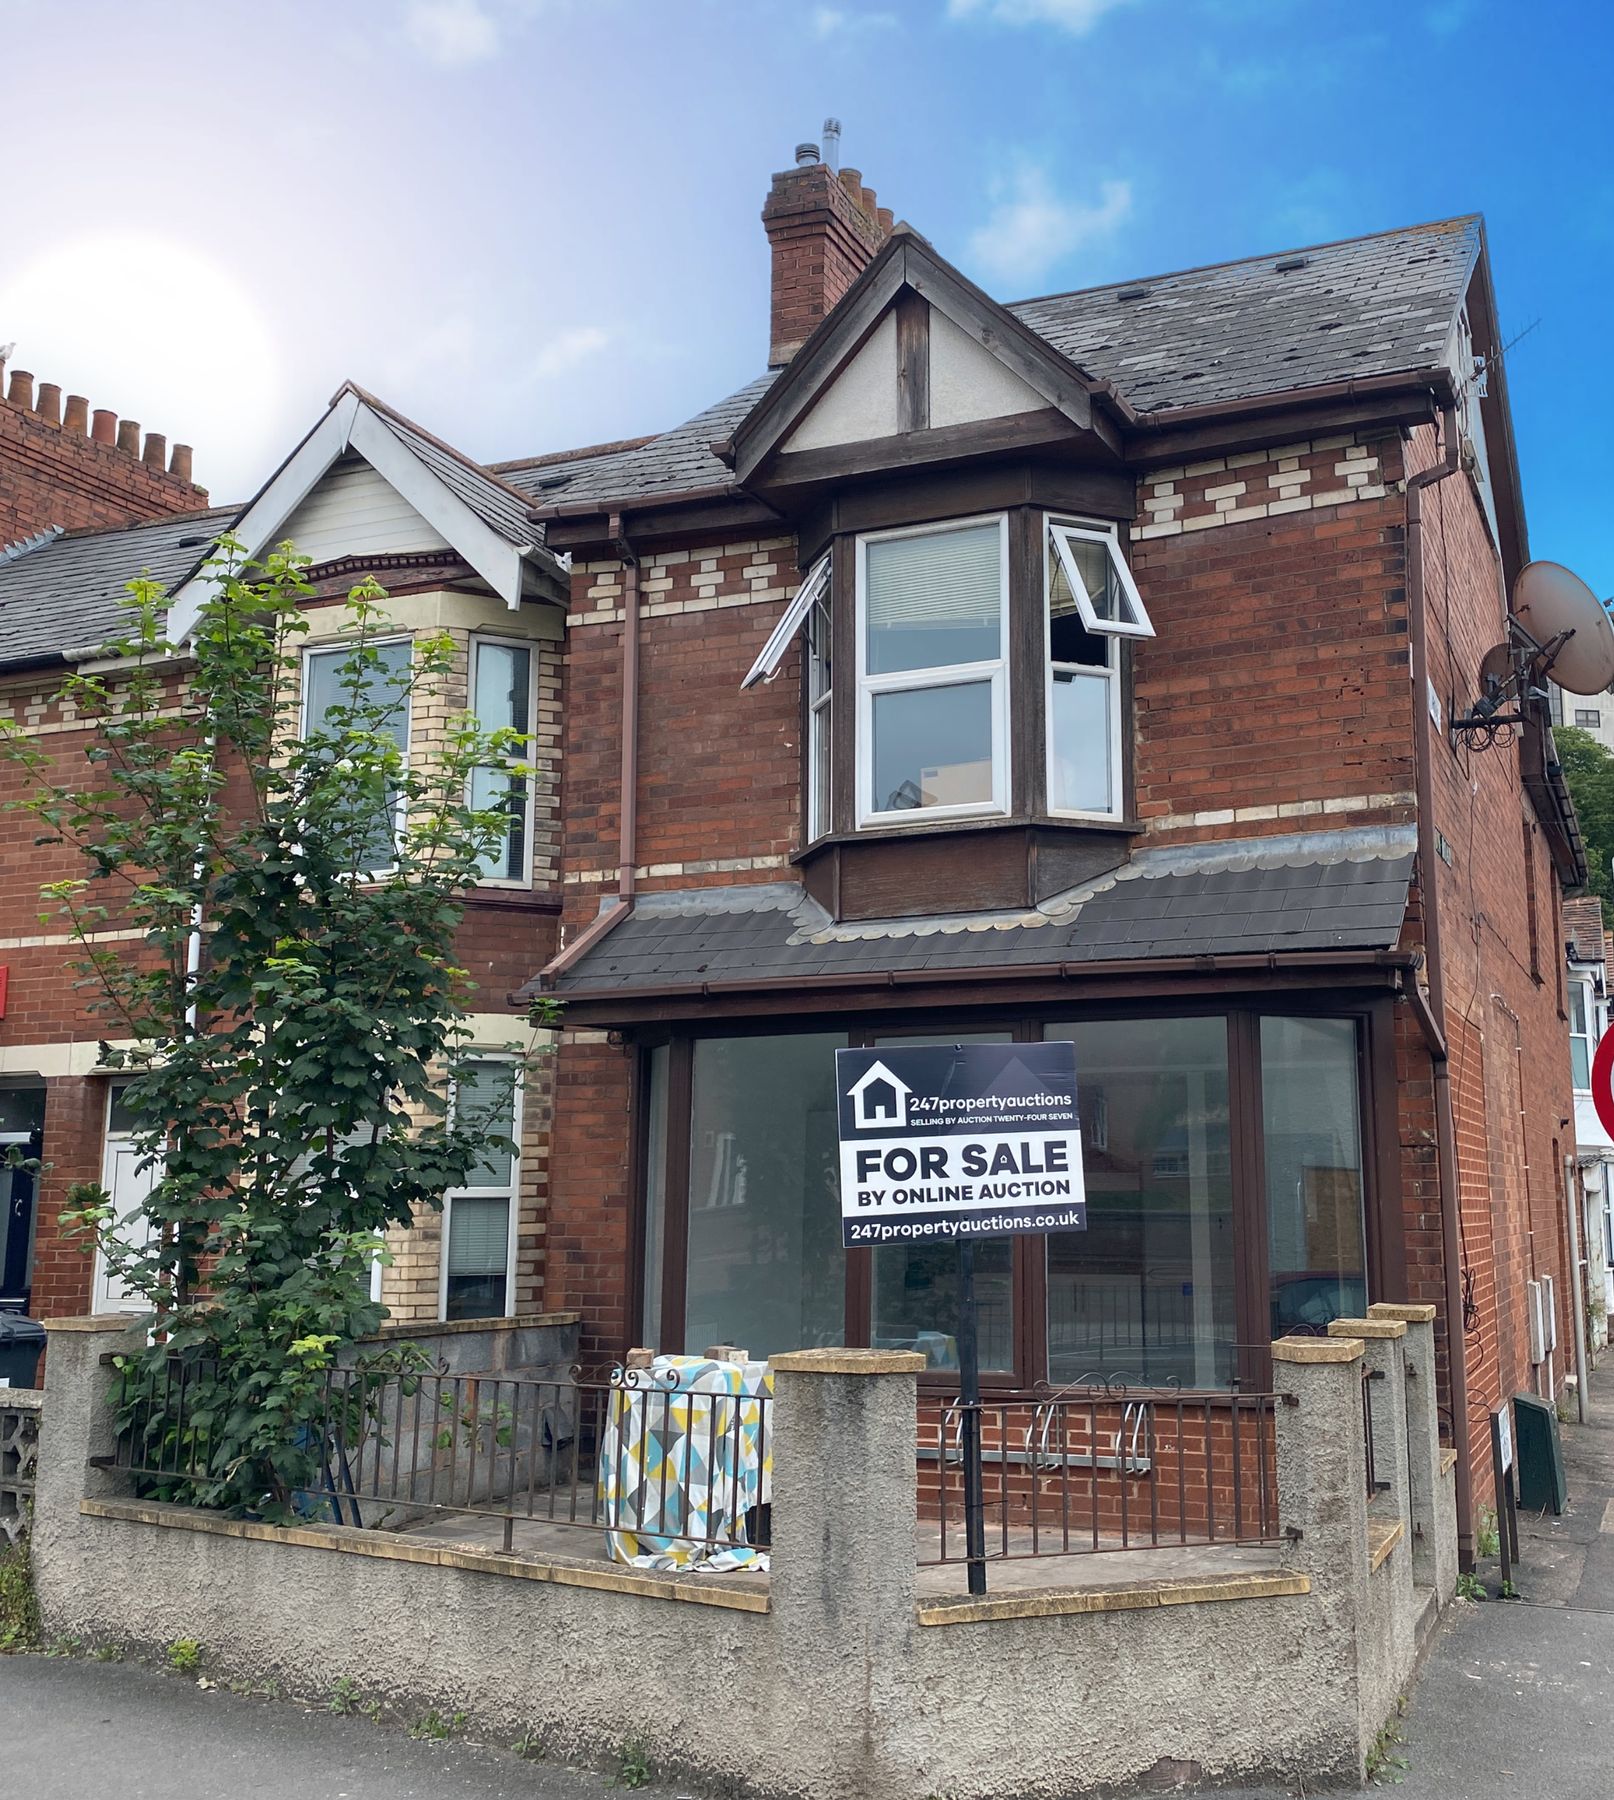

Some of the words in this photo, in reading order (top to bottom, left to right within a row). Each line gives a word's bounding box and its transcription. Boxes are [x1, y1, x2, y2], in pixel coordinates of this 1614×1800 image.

[909, 1093, 1072, 1113] 247propertyauctions
[910, 1117, 944, 1126] SELLING
[945, 1117, 956, 1125] BY
[957, 1115, 992, 1124] AUCTION
[993, 1113, 1047, 1123] TWENTY-FOUR
[1047, 1112, 1073, 1120] SEVEN
[856, 1146, 950, 1183] FOR
[961, 1140, 1069, 1177] SALE
[857, 1190, 886, 1207] BY
[892, 1185, 973, 1205] ONLINE
[979, 1179, 1070, 1200] AUCTION
[850, 1211, 1079, 1240] 247propertyauctions.co.uk
